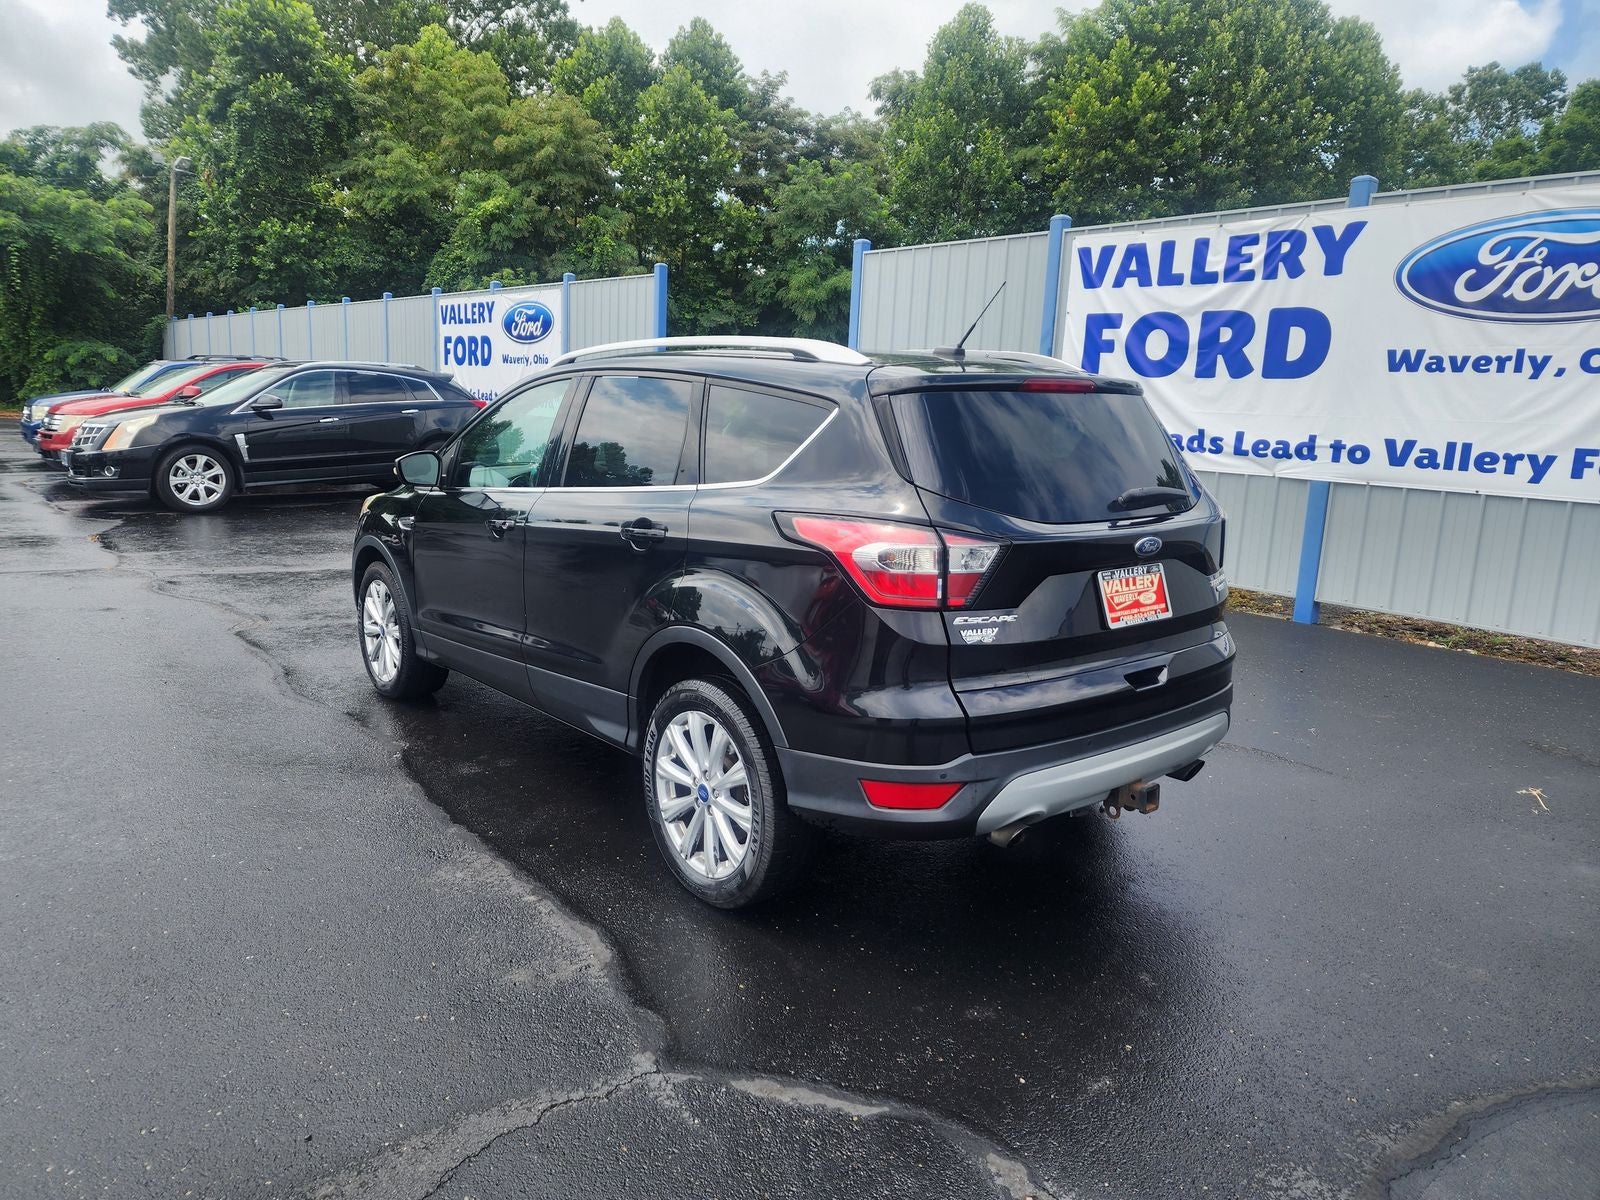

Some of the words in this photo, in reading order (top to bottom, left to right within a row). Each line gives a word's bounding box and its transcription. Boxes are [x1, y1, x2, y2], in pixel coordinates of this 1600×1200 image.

[1077, 220, 1368, 290] VALLERY
[1454, 230, 1600, 303] For
[440, 301, 495, 325] VALLERY
[511, 308, 543, 338] Ford
[443, 335, 492, 367] FORD
[1081, 307, 1332, 380] FORD
[533, 354, 549, 365] Ohio
[1387, 348, 1566, 380] Waverly,
[1170, 428, 1224, 454] ads
[1233, 431, 1318, 461] Lead
[1330, 439, 1371, 465] to
[1384, 438, 1558, 484] Vallery
[1103, 573, 1160, 594] VALLERY
[1114, 565, 1148, 578] VALLERY
[953, 614, 1018, 625] ESCAPE
[960, 627, 999, 637] VALLERY
